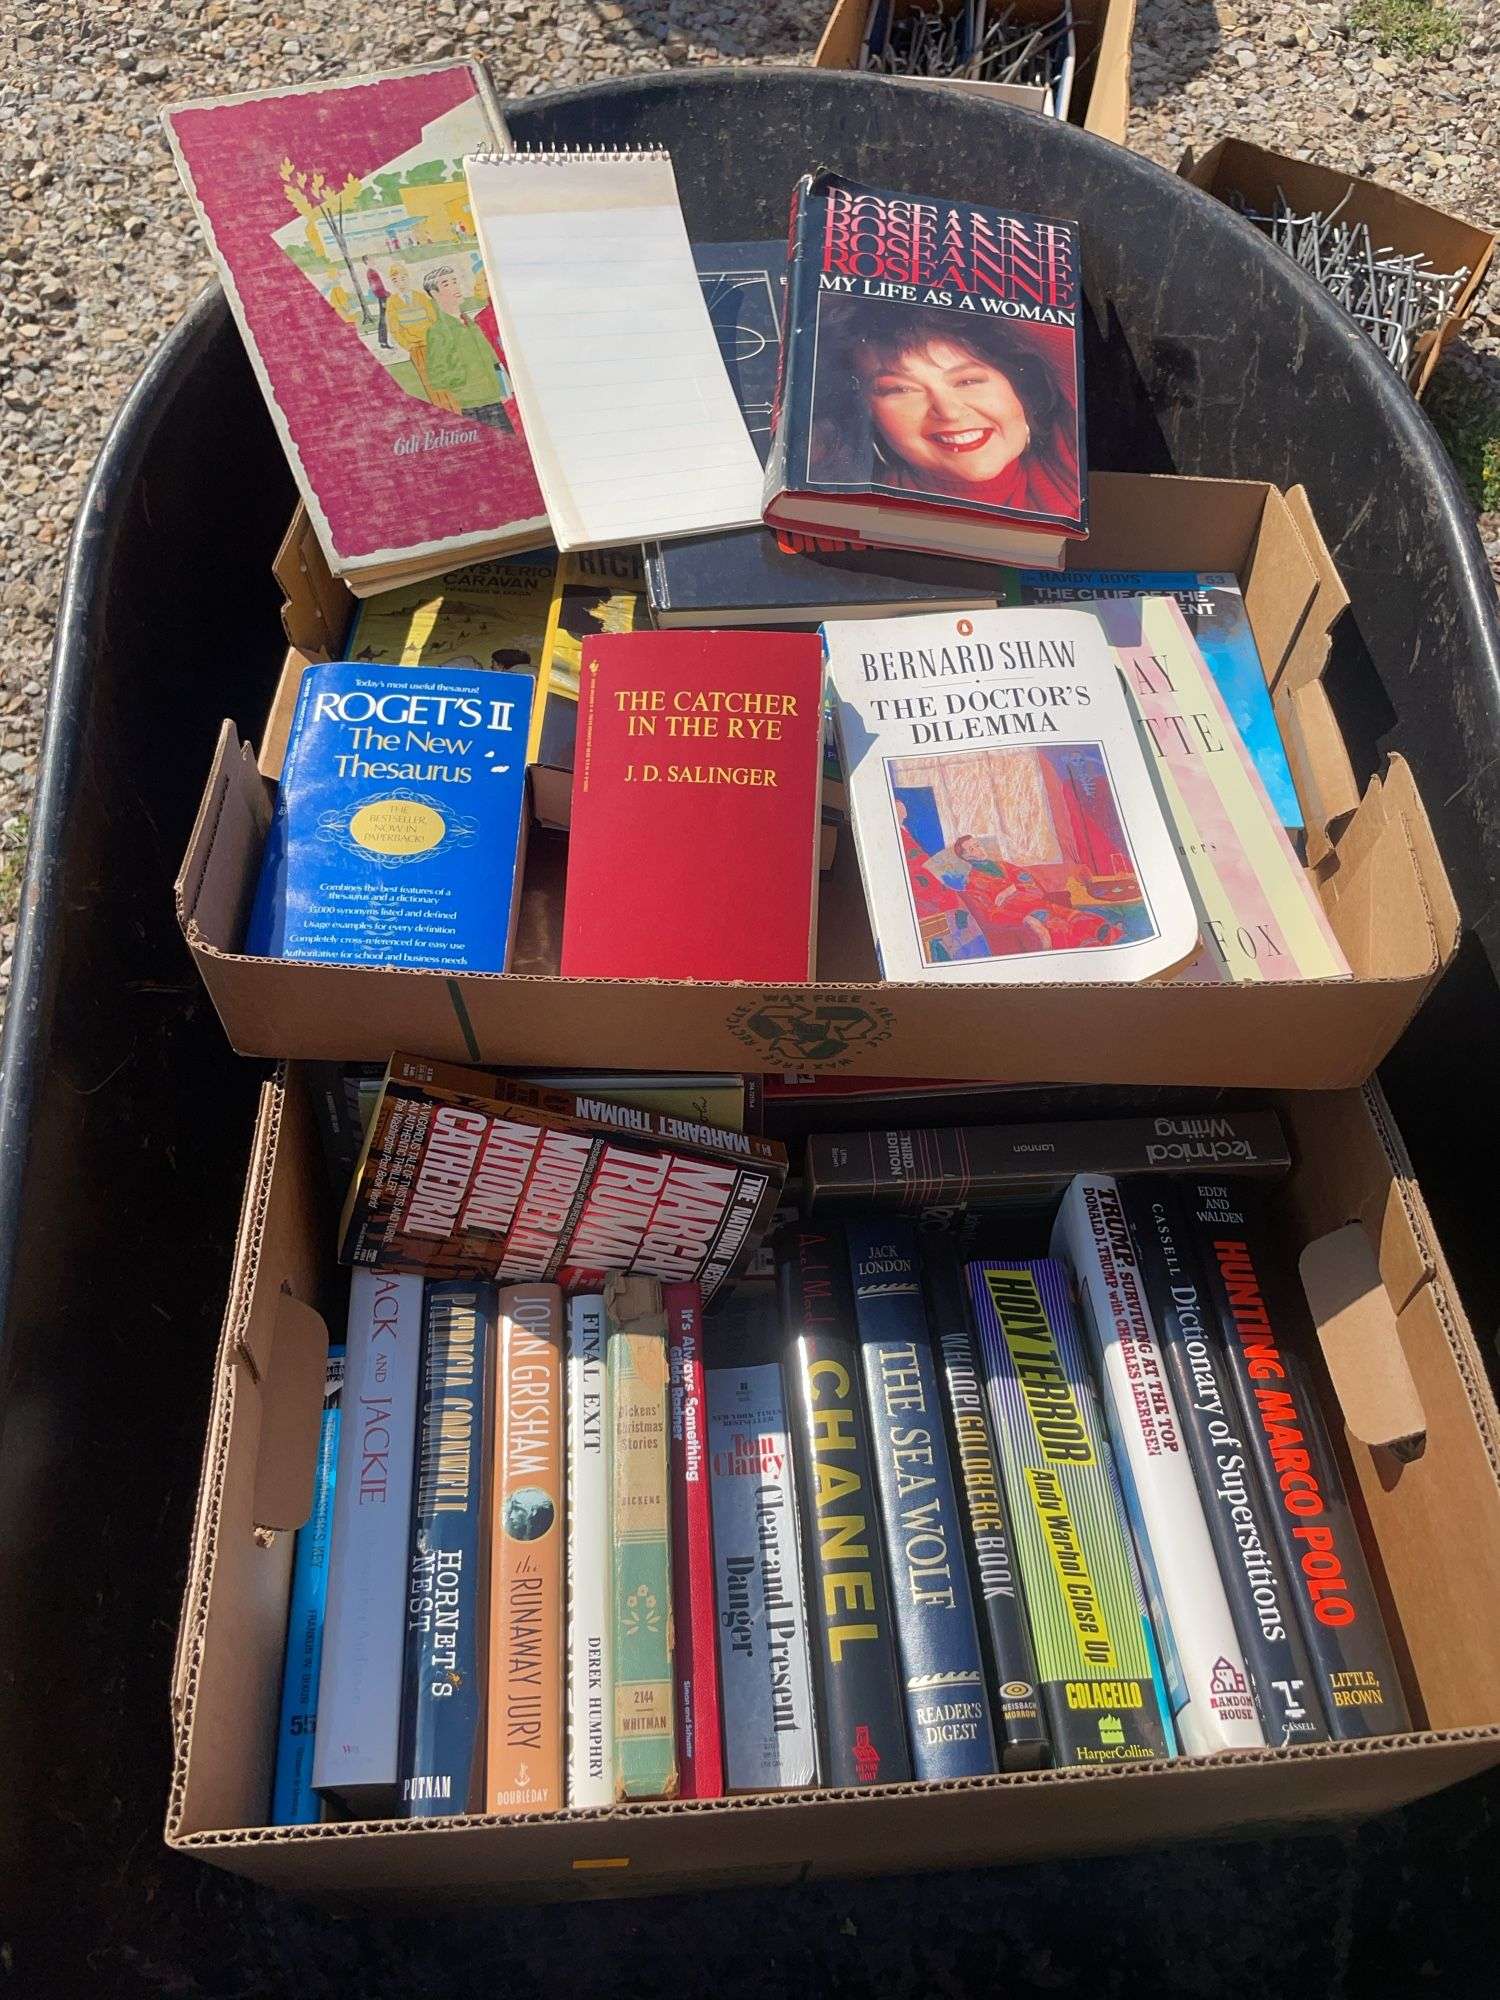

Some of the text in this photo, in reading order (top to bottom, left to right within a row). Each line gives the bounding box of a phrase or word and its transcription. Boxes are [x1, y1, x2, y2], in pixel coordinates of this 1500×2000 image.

[822, 246, 1075, 310] ROSEANNE
[819, 274, 1075, 327] MY LIFE AS A WOMAN
[393, 427, 480, 456] 6th Edition
[442, 574, 538, 589] CARAVAN
[1039, 572, 1141, 584] HARDY BOYS
[1206, 576, 1226, 585] 53
[1033, 587, 1210, 603] THE CLUE THE
[860, 640, 1076, 682] BERNARD SHAW
[355, 679, 386, 689] Today's
[387, 682, 409, 690] most
[410, 682, 436, 692] useful
[312, 692, 515, 731] ROGET'S II
[614, 690, 799, 718] THE CATCHER
[870, 686, 1091, 721] THE DOCTOR'S
[349, 726, 474, 757] The New
[627, 715, 783, 741] IN THE RYE
[910, 711, 1059, 745] DILEMMA
[334, 754, 473, 784] Thesaurus
[624, 765, 778, 787] J. D. SALINGER
[319, 883, 433, 895] Combines best features
[328, 892, 440, 905] thesaurus and dictionary
[303, 920, 456, 935] Usage examples every definition
[336, 907, 457, 920] synonyms listed and defined
[282, 948, 469, 965] Authoritative school and business needs
[289, 934, 466, 951] Completely easy use
[762, 994, 862, 1004] WAX FREE
[575, 1096, 653, 1133] TRUMAN
[1153, 1117, 1234, 1141] Writing
[659, 1116, 752, 1155] MARGARET
[1012, 1142, 1055, 1154] Lannon
[885, 1131, 903, 1176] EDITION
[898, 1135, 914, 1169] THIRD
[1146, 1140, 1257, 1164] Technical
[403, 1107, 488, 1238] CATHEDRAL
[461, 1118, 541, 1234] NATIONAL
[516, 1130, 595, 1233] MURDER
[738, 1176, 763, 1206] THE
[1198, 1186, 1228, 1198] EDDY
[1205, 1199, 1230, 1210] AND
[562, 1144, 672, 1275] TRUMAN
[1196, 1212, 1244, 1224] WALDEN
[713, 1205, 753, 1260] NATIONAL
[868, 1245, 897, 1259] JACK
[858, 1260, 911, 1275] LONDON
[1098, 1187, 1179, 1453] TRUMP: SURVIVING AT THE TOP
[583, 1312, 601, 1383] FINAL
[1097, 1245, 1163, 1458] TRUMP CHARLES LEERHSEN
[988, 1275, 1093, 1463] HOLY TERROR
[359, 1267, 400, 1506] JACK AND JACKIE
[509, 1295, 551, 1478] JOHN GRISHAM
[670, 1346, 684, 1441] Gilda Radner
[417, 1293, 477, 1518] PATRICIA CORNWELL
[617, 1403, 660, 1418] Dickens'
[682, 1335, 701, 1482] Always Something
[583, 1393, 602, 1455] EXIT
[617, 1422, 664, 1434] Christmas
[1151, 1203, 1287, 1641] CASSELL Dictionary of Superstitions
[1213, 1240, 1357, 1628] HUNTING MARCO POLO
[621, 1437, 658, 1450] Stories
[731, 1433, 775, 1457] Tom
[713, 1451, 785, 1480] Clancy
[880, 1342, 957, 1610] THE SEA WOLF
[940, 1332, 1015, 1600] WHOOPI GOLDBERG BOOK
[754, 1484, 784, 1555] Clear
[808, 1360, 879, 1663] CHANEL
[1029, 1468, 1111, 1664] Andy Warhol Close Up
[409, 1554, 433, 1632] NEST
[762, 1557, 794, 1612] and
[721, 1555, 756, 1658] Danger
[430, 1549, 463, 1698] HORNET'S
[507, 1577, 543, 1750] RUNAWAY JURY
[766, 1613, 801, 1733] Present
[1329, 1671, 1380, 1687] LITTLE,
[587, 1637, 603, 1780] DEREK HUMPHRY
[633, 1691, 654, 1704] 2144
[1065, 1682, 1142, 1710] COLACELLO
[1210, 1694, 1253, 1708] RANDOM
[1334, 1689, 1384, 1706] BROWN
[622, 1716, 667, 1731] WHITMAN
[916, 1703, 982, 1724] READER'S
[1004, 1711, 1036, 1720] MORROW
[1220, 1709, 1253, 1720] HOUSE
[1282, 1721, 1316, 1732] CASSELL
[926, 1723, 977, 1744] DIGEST
[1077, 1745, 1154, 1763] HarperCollins
[402, 1776, 452, 1801] PUTNAM
[497, 1787, 549, 1806] DOUBLEDAY
